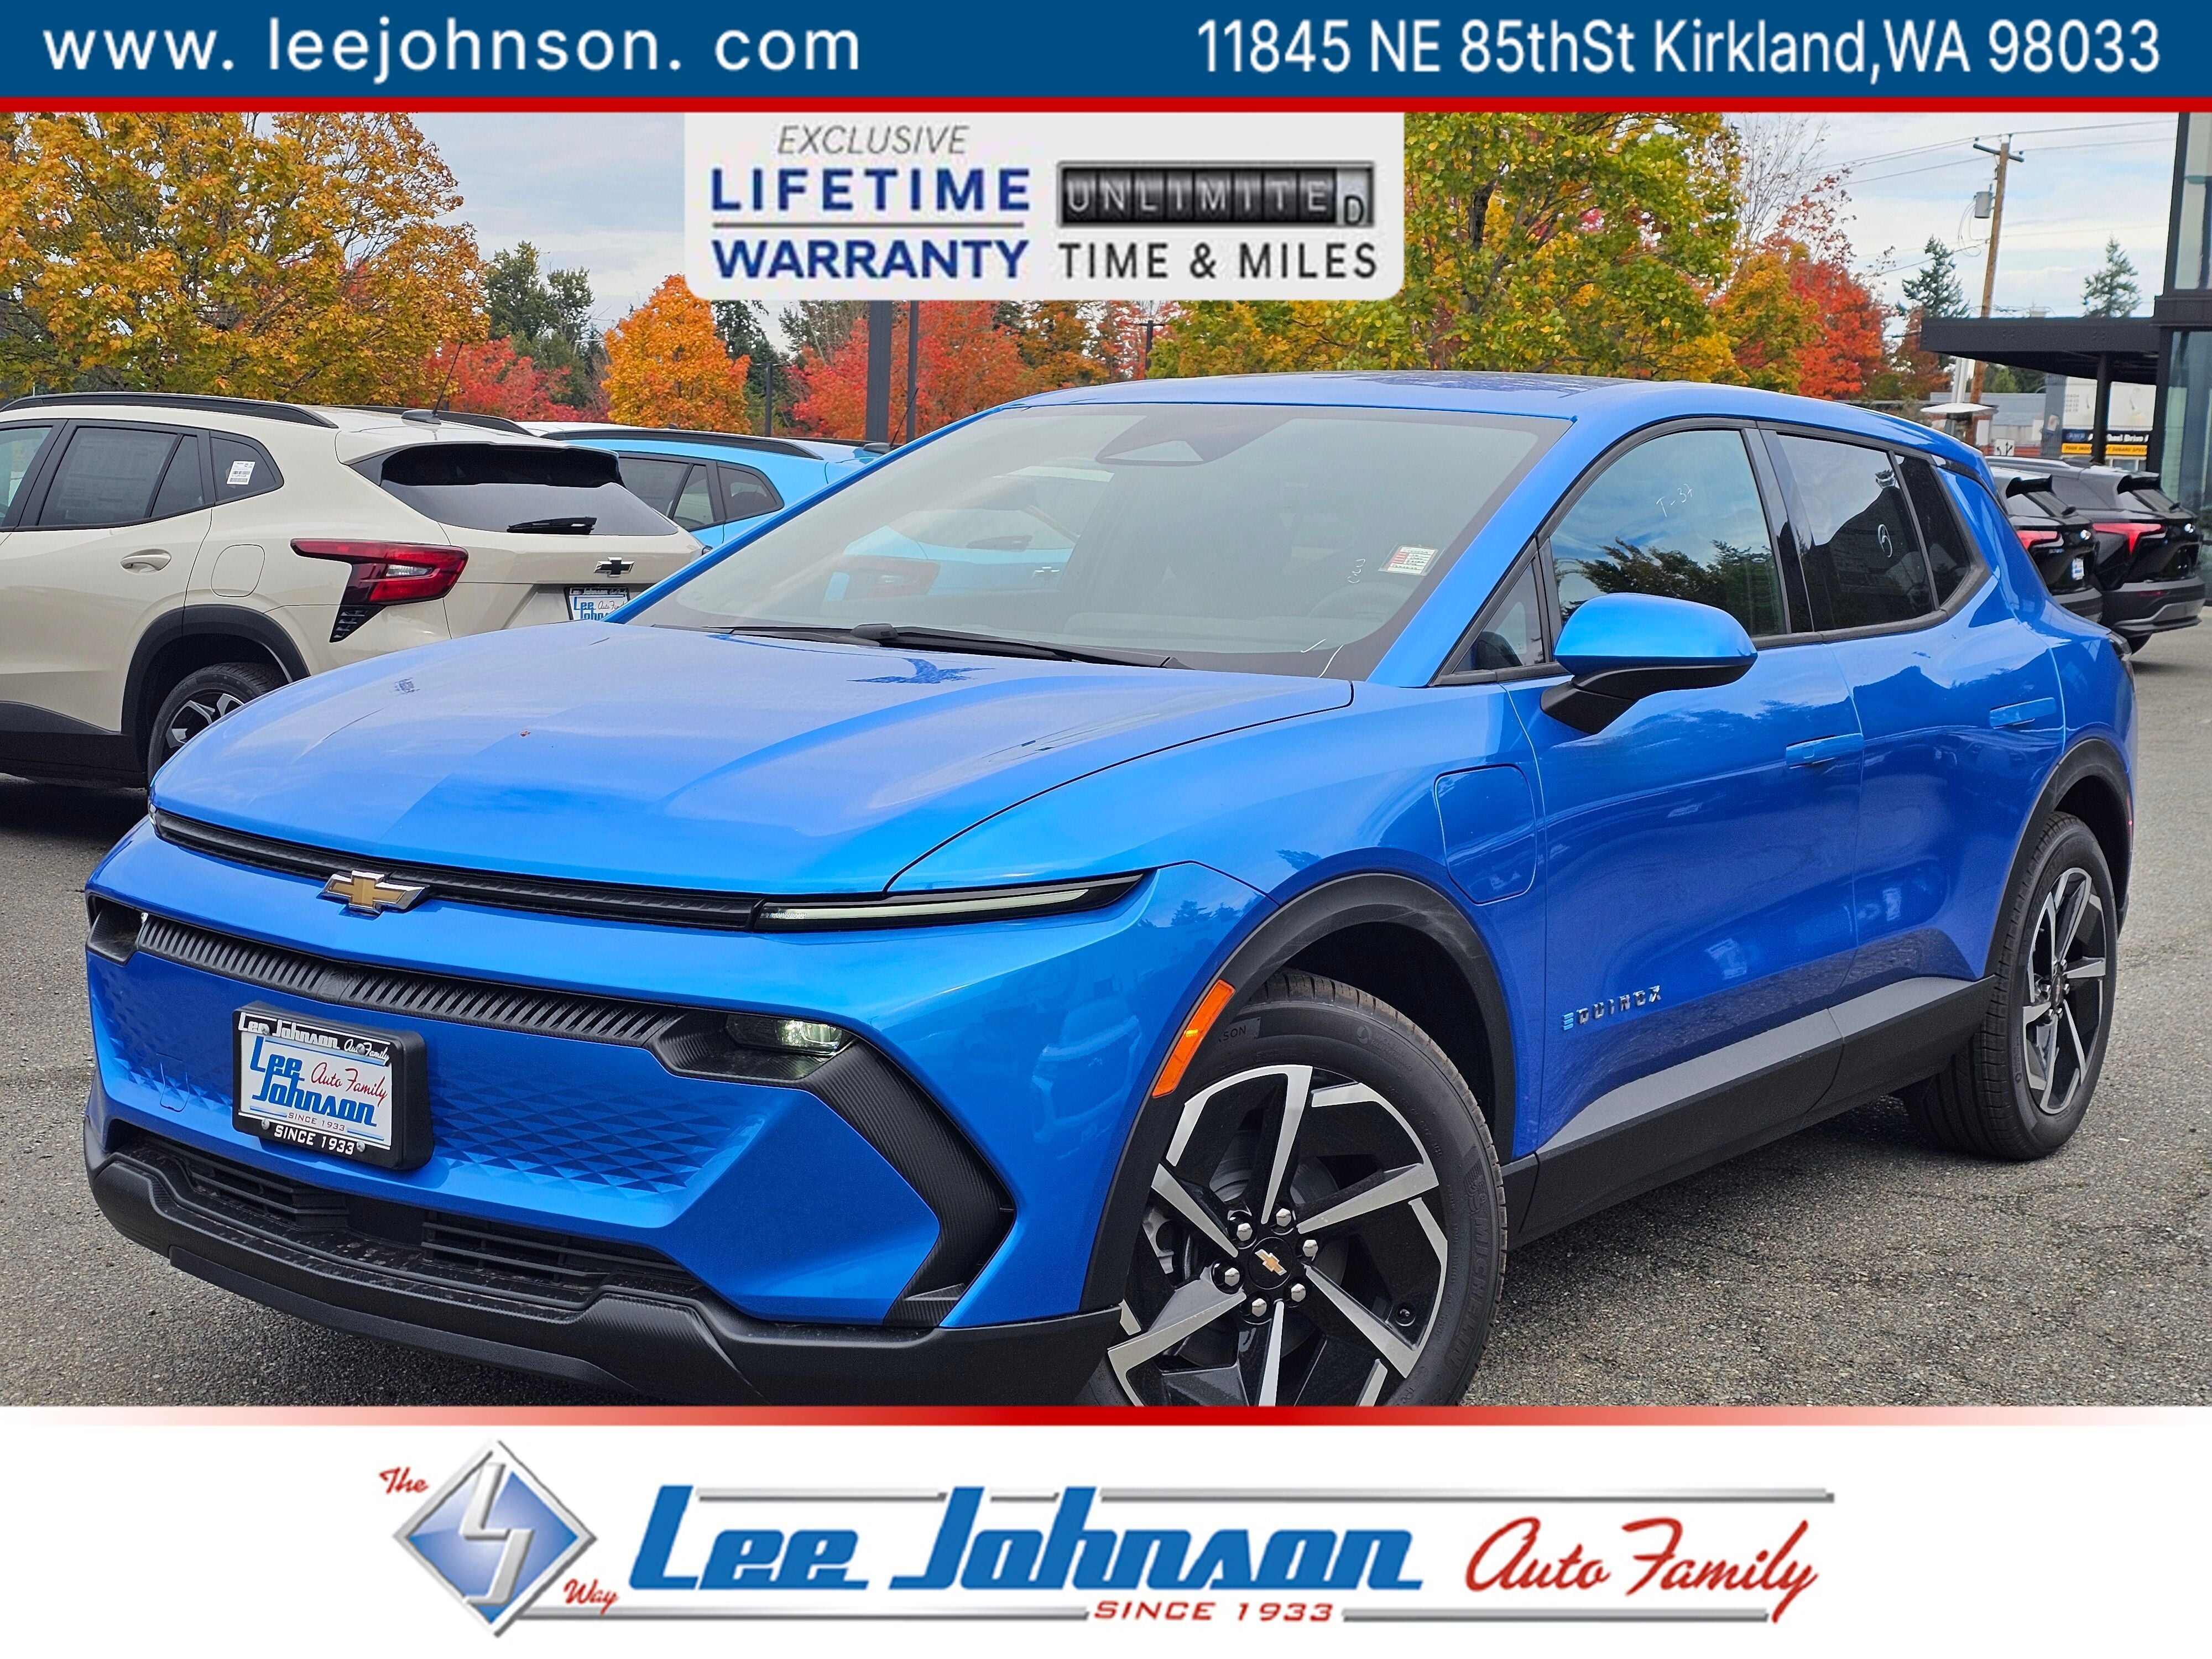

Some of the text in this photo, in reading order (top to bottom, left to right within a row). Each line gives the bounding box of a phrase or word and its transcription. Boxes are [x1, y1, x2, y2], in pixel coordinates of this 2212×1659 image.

[573, 597, 596, 611] Lee
[1562, 985, 1661, 1031] EQUINOX
[272, 1019, 341, 1050] Johnson
[363, 1042, 390, 1065] Family
[1219, 1025, 1246, 1043] SON
[250, 1036, 305, 1082] Lee
[252, 1067, 377, 1127] Johnson
[311, 1062, 388, 1107] Auto Family
[274, 1125, 355, 1155] SINCE 1933
[288, 1112, 345, 1132] SINCE 1933
